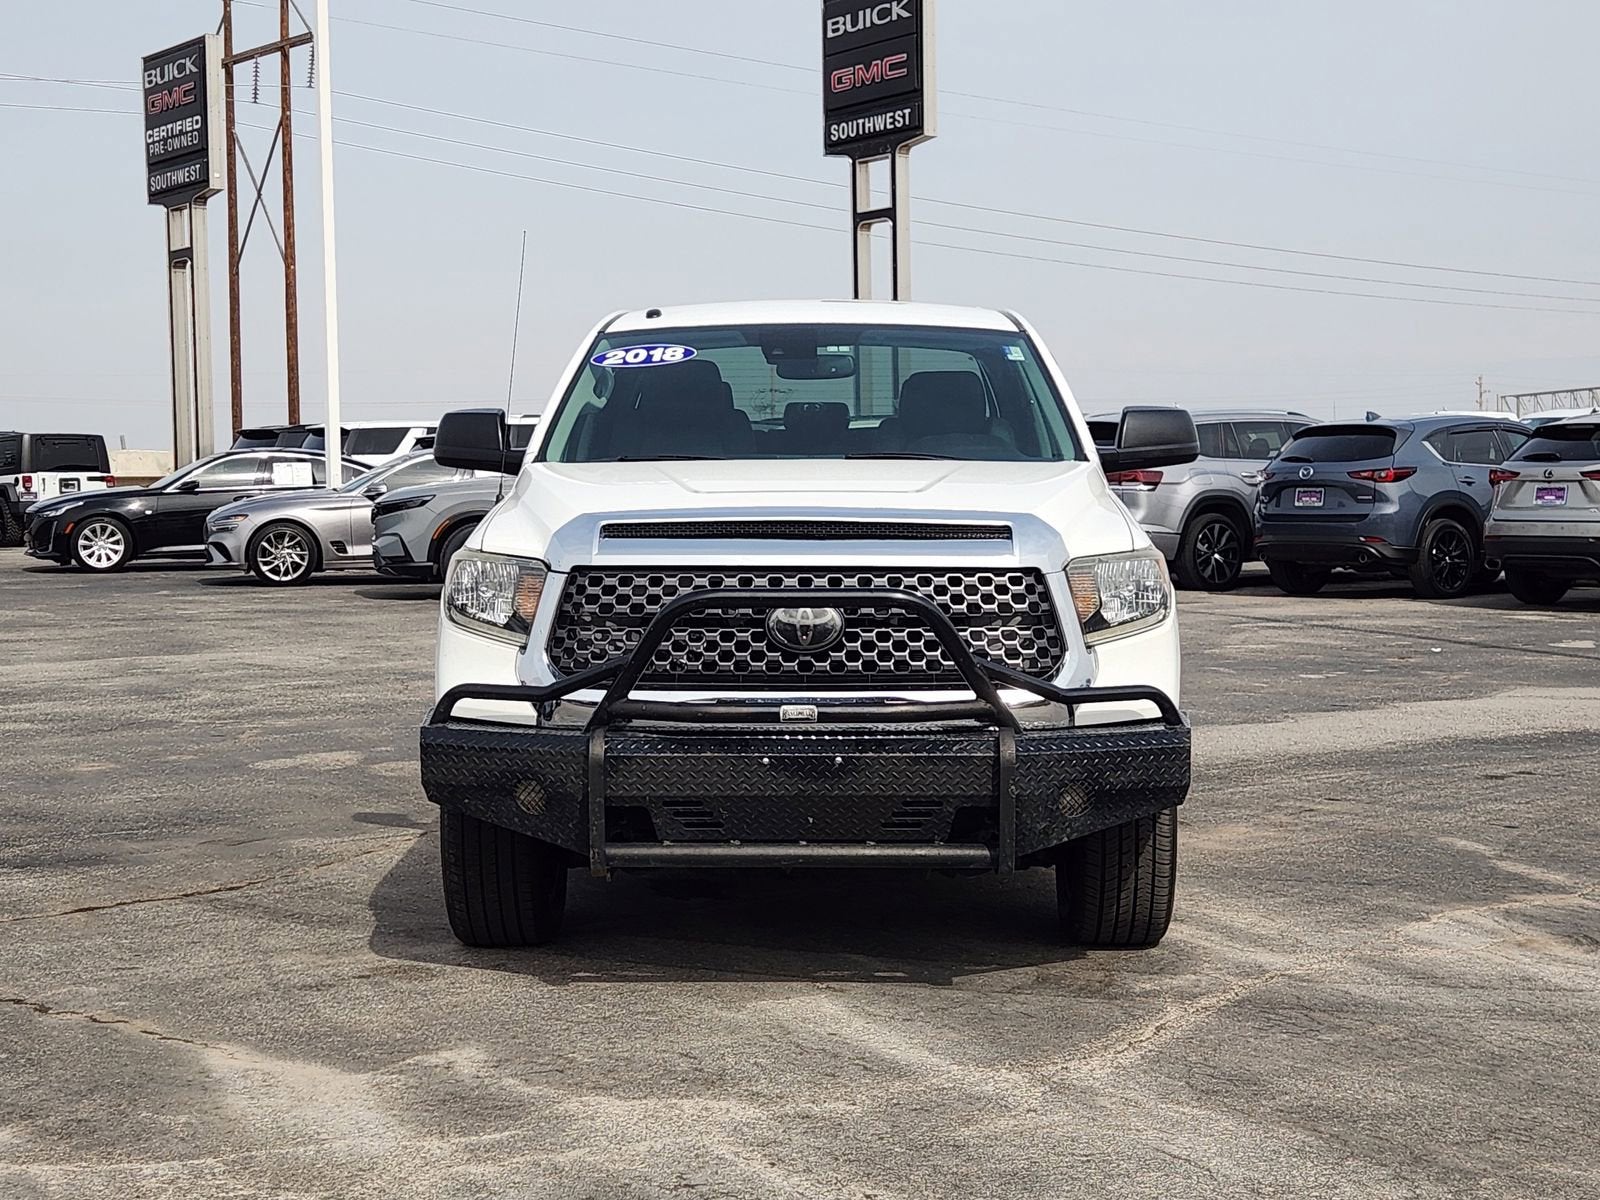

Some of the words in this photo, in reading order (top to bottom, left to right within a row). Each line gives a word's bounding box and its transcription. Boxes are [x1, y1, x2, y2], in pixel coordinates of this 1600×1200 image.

[827, 0, 912, 38] BUICK
[144, 54, 199, 89] BUICK
[831, 53, 907, 92] GMC
[148, 82, 195, 114] GMC
[146, 115, 201, 143] CERTIFIED
[830, 108, 911, 141] SOUTHWEST
[149, 131, 199, 156] PRE-OWNED
[150, 164, 201, 191] SOUTHWEST
[602, 347, 685, 365] 2018
